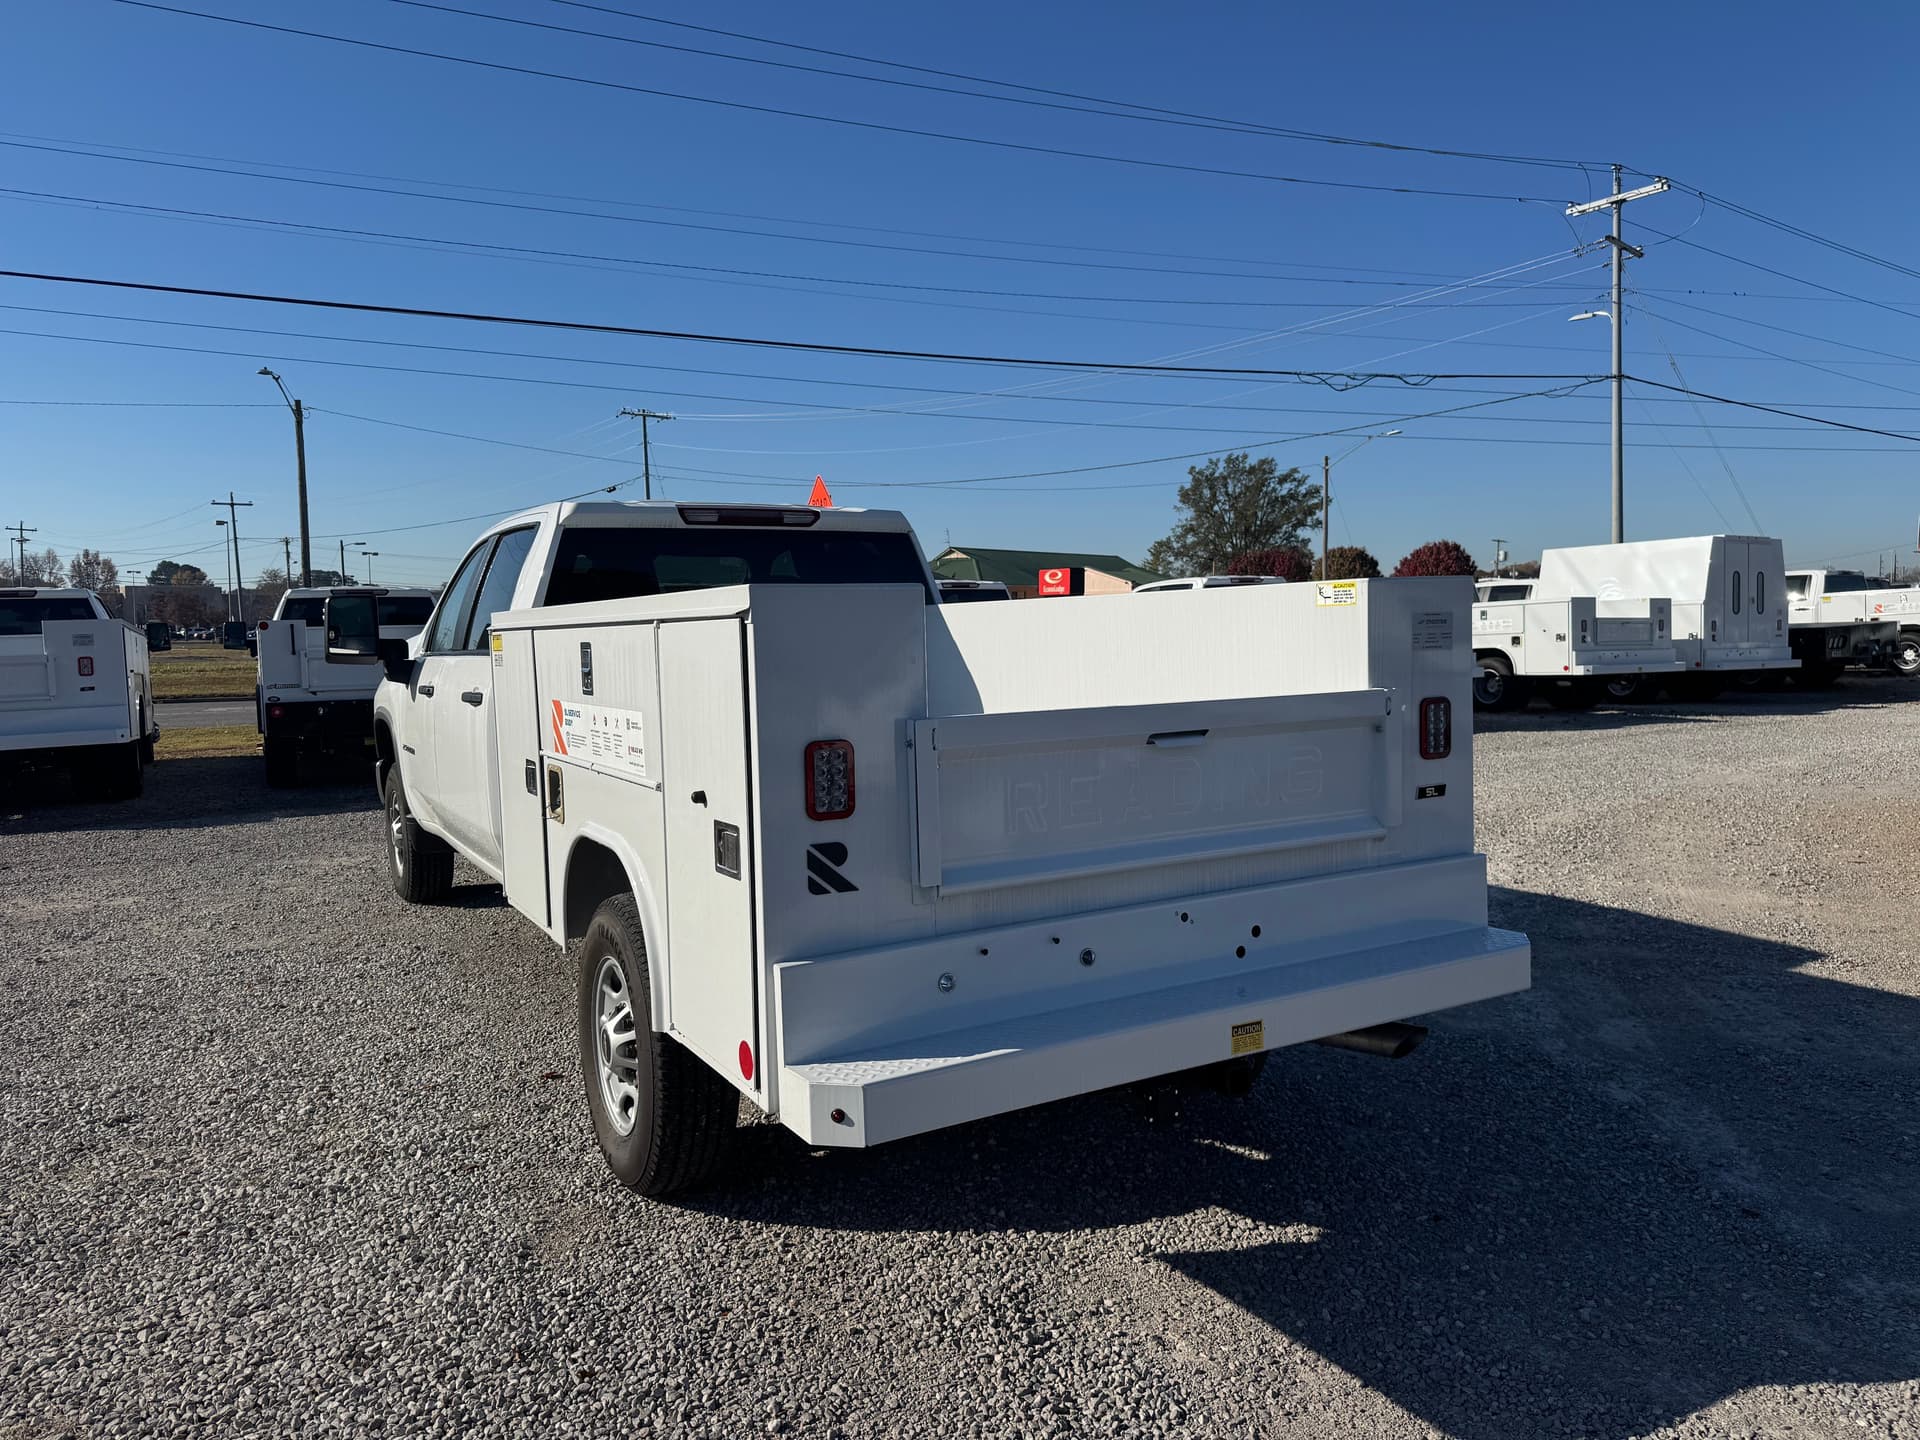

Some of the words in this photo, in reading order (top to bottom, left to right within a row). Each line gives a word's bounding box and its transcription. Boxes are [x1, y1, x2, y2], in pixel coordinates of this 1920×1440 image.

[1007, 745, 1325, 834] READING
[1425, 787, 1439, 797] SL
[1233, 1023, 1261, 1036] CAUTION
